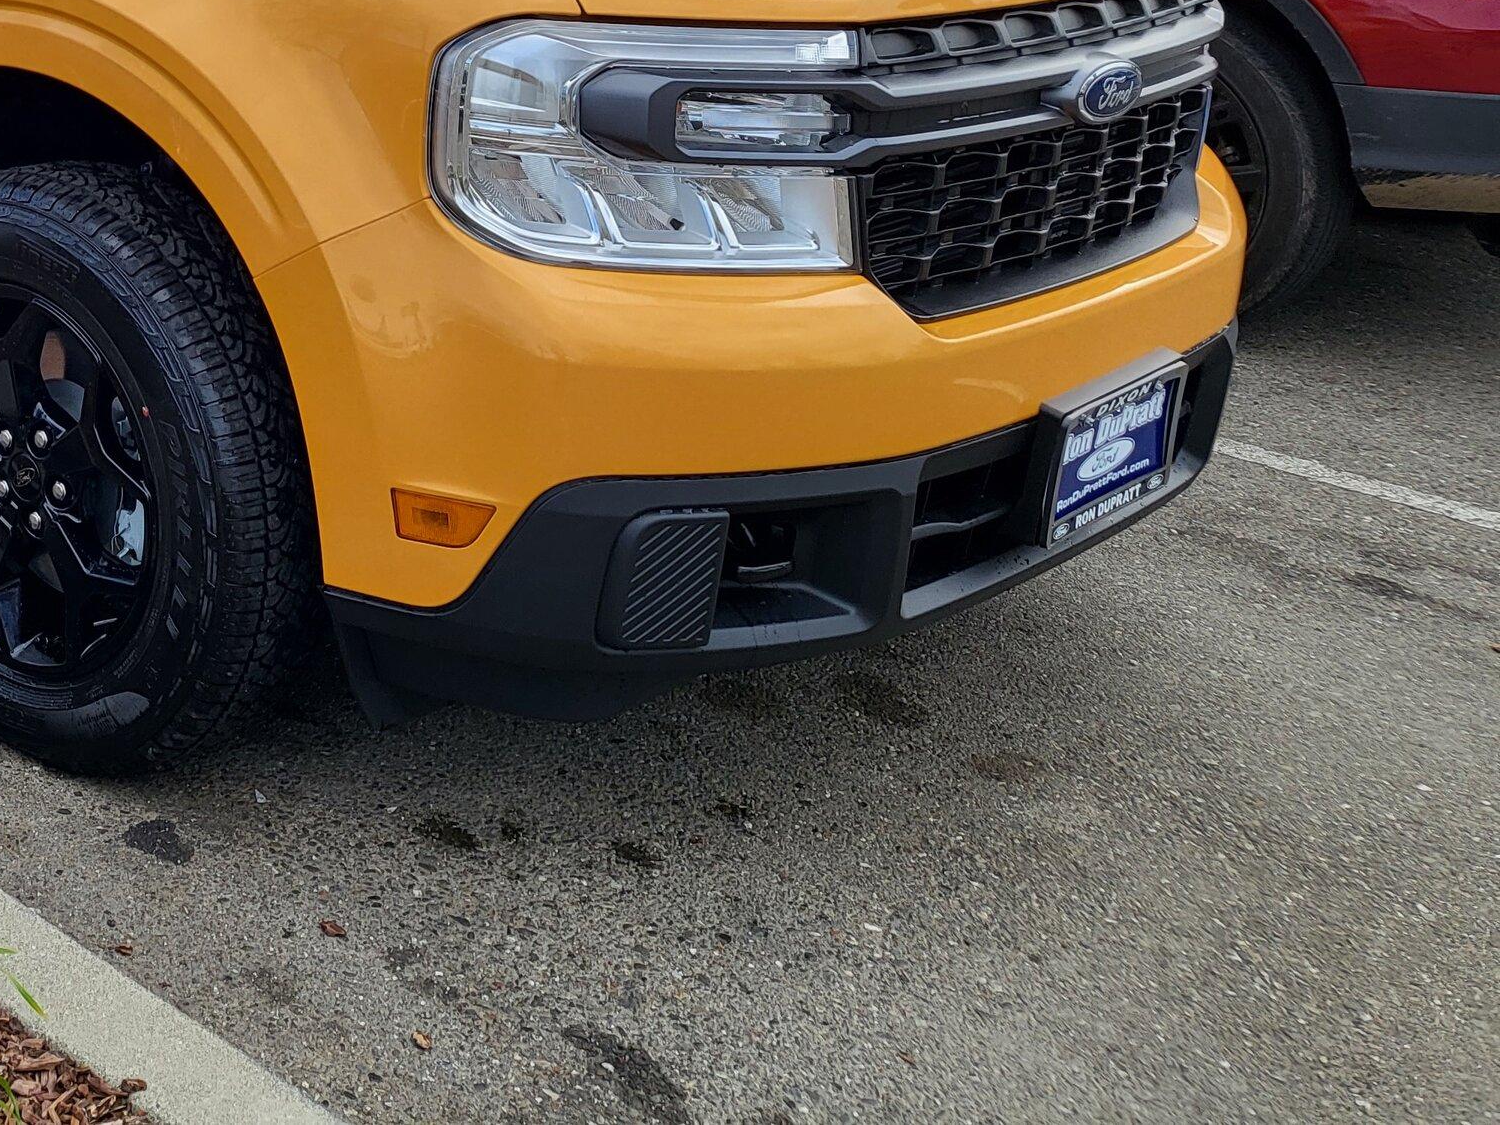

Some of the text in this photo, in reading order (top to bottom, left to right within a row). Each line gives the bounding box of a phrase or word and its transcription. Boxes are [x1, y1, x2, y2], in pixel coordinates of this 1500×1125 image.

[1098, 75, 1135, 110] Ford
[1096, 381, 1152, 417] DIXON
[1056, 458, 1150, 513] RonDuPrattFord.com
[1075, 483, 1142, 529] RON DUPRATT
